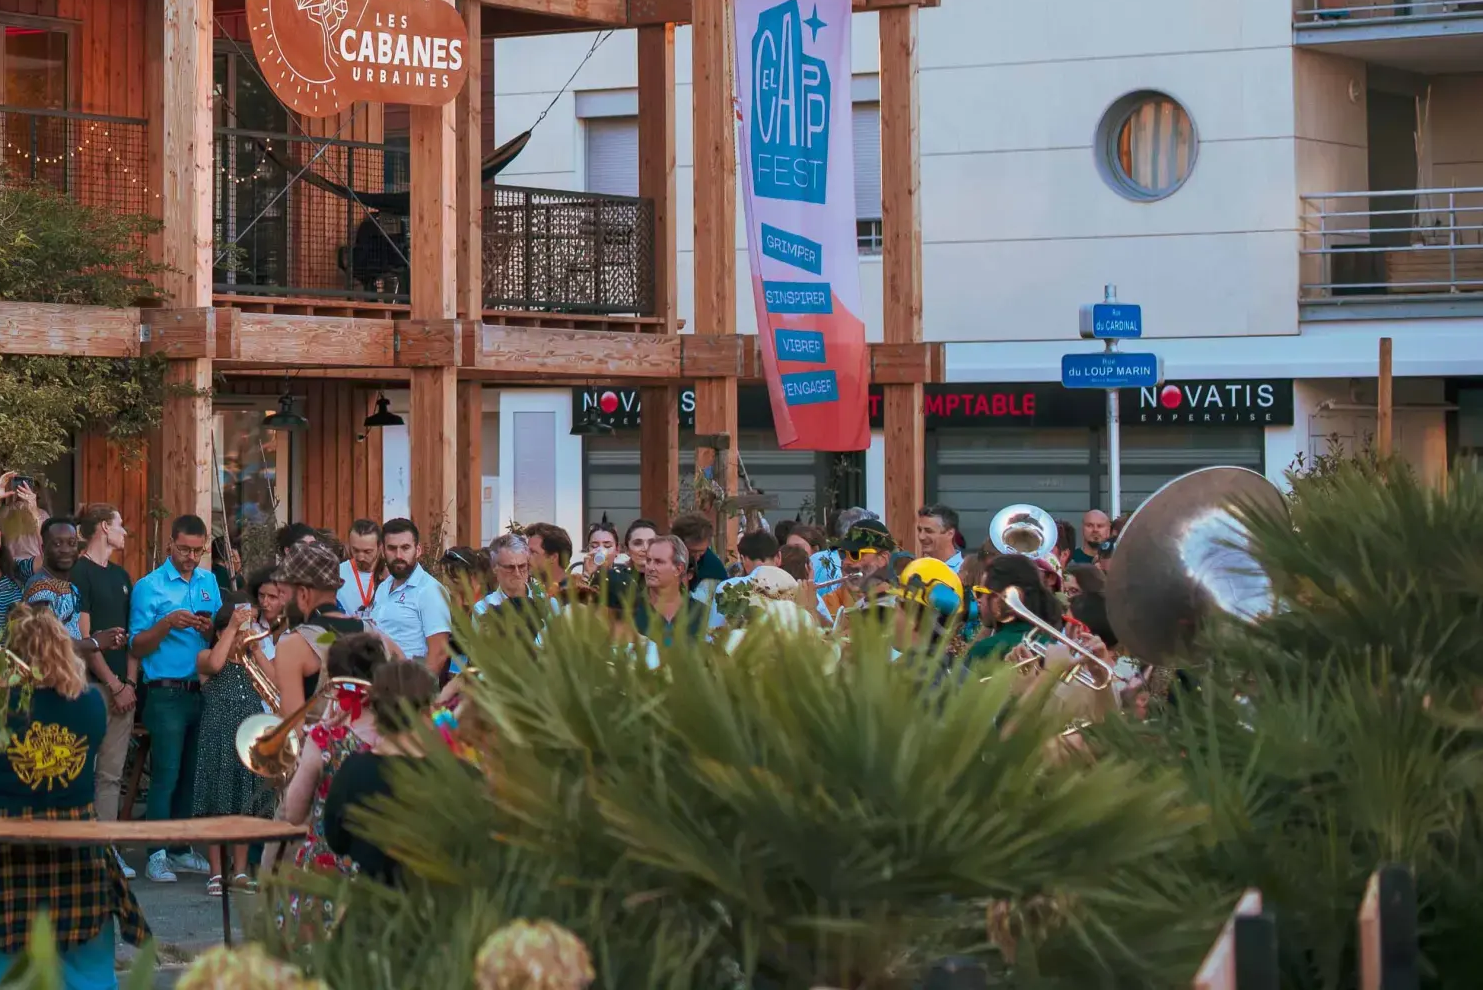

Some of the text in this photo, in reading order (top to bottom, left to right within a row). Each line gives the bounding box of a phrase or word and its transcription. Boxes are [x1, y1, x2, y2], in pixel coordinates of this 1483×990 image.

[375, 12, 408, 29] LES
[339, 28, 463, 71] CABANES
[352, 66, 449, 88] URBAINES
[755, 11, 826, 149] CAPP
[762, 68, 777, 90] EL
[757, 153, 824, 190] FEST
[766, 234, 816, 264] GRIMPER
[1096, 320, 1138, 331] du CARDINAL
[1068, 366, 1152, 377] du LOUP MARIN
[924, 393, 1036, 417] MPTABLE
[1140, 413, 1272, 422] EXPERTISE
